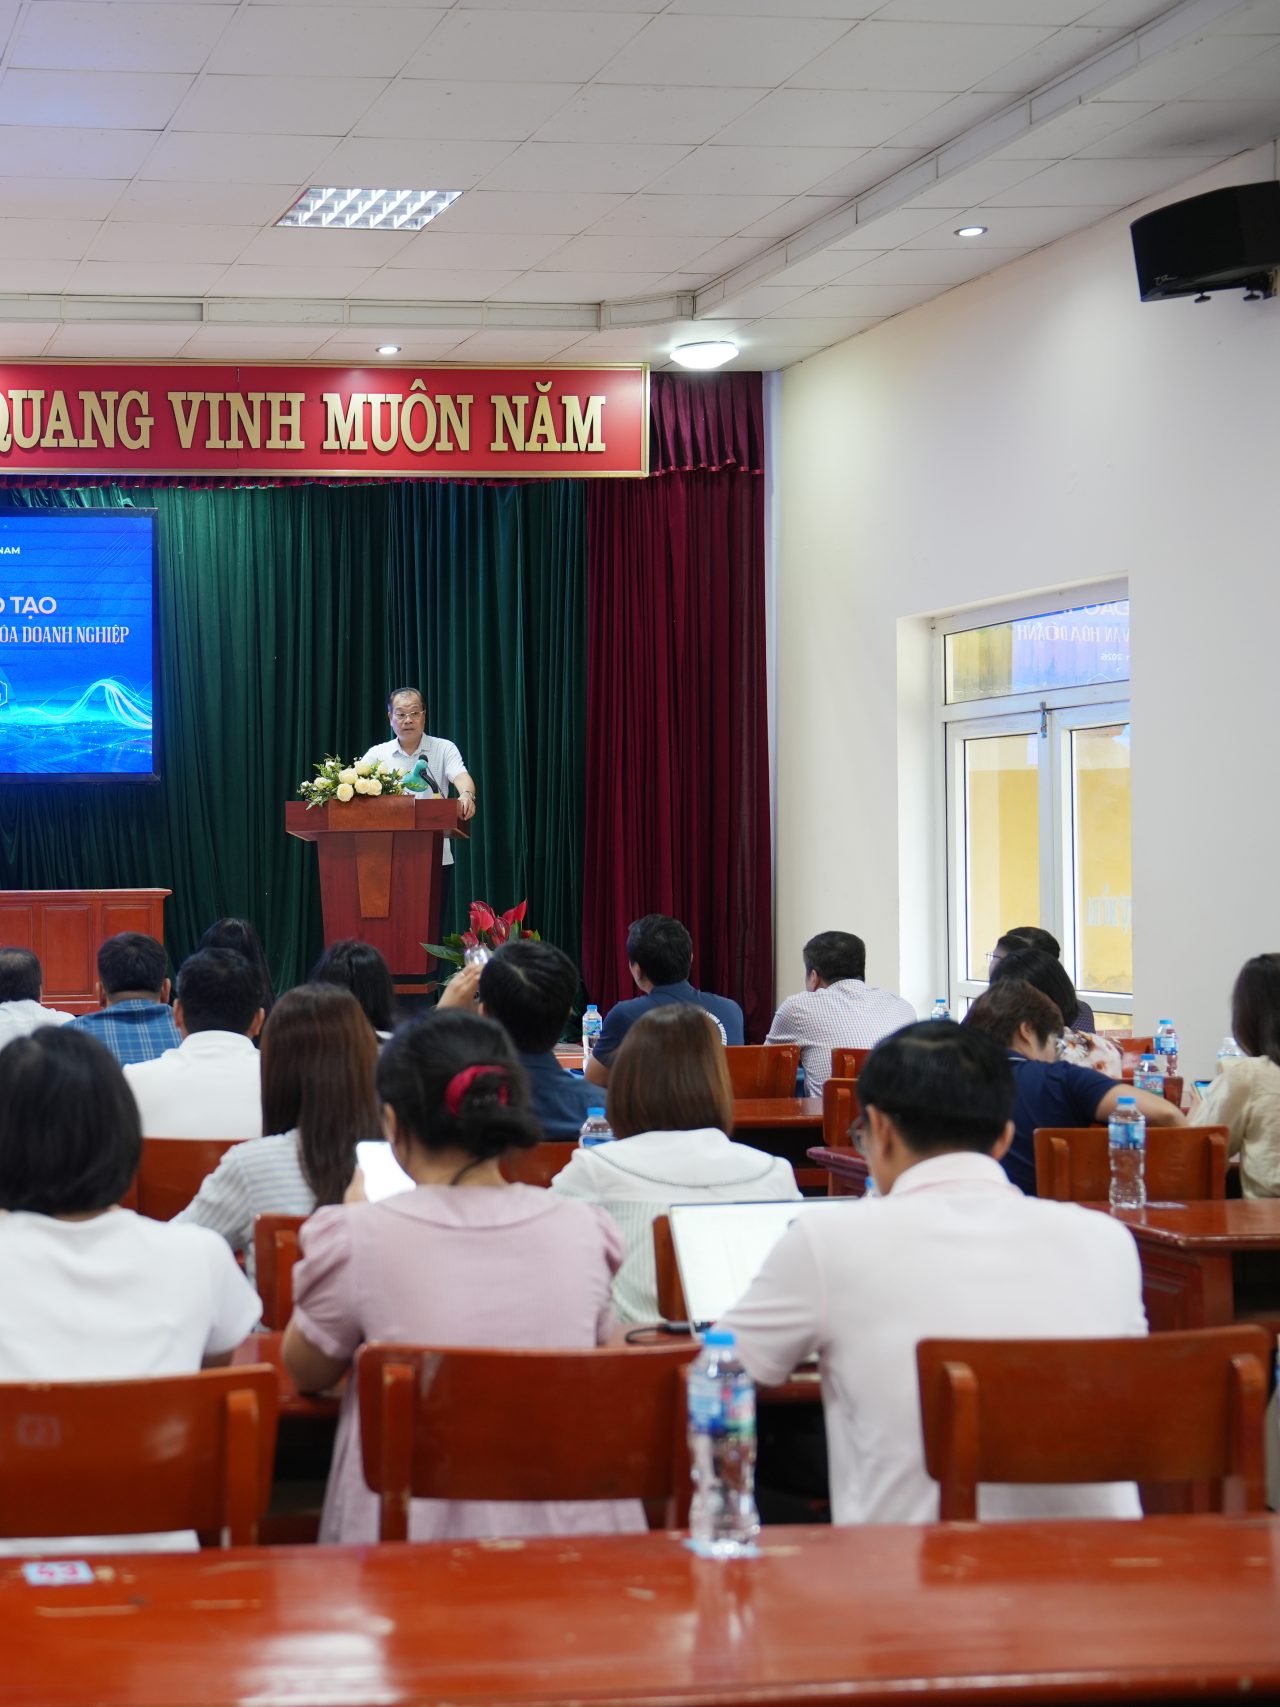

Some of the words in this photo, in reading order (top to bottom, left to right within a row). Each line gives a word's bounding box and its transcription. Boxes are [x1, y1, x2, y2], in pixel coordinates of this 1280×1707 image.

[167, 391, 306, 450] VINH
[322, 378, 475, 452] MUÔN
[490, 380, 607, 453] NĂM
[10, 596, 57, 620] TẠO
[22, 626, 73, 644] DOANH
[76, 624, 130, 645] NGHIỆP
